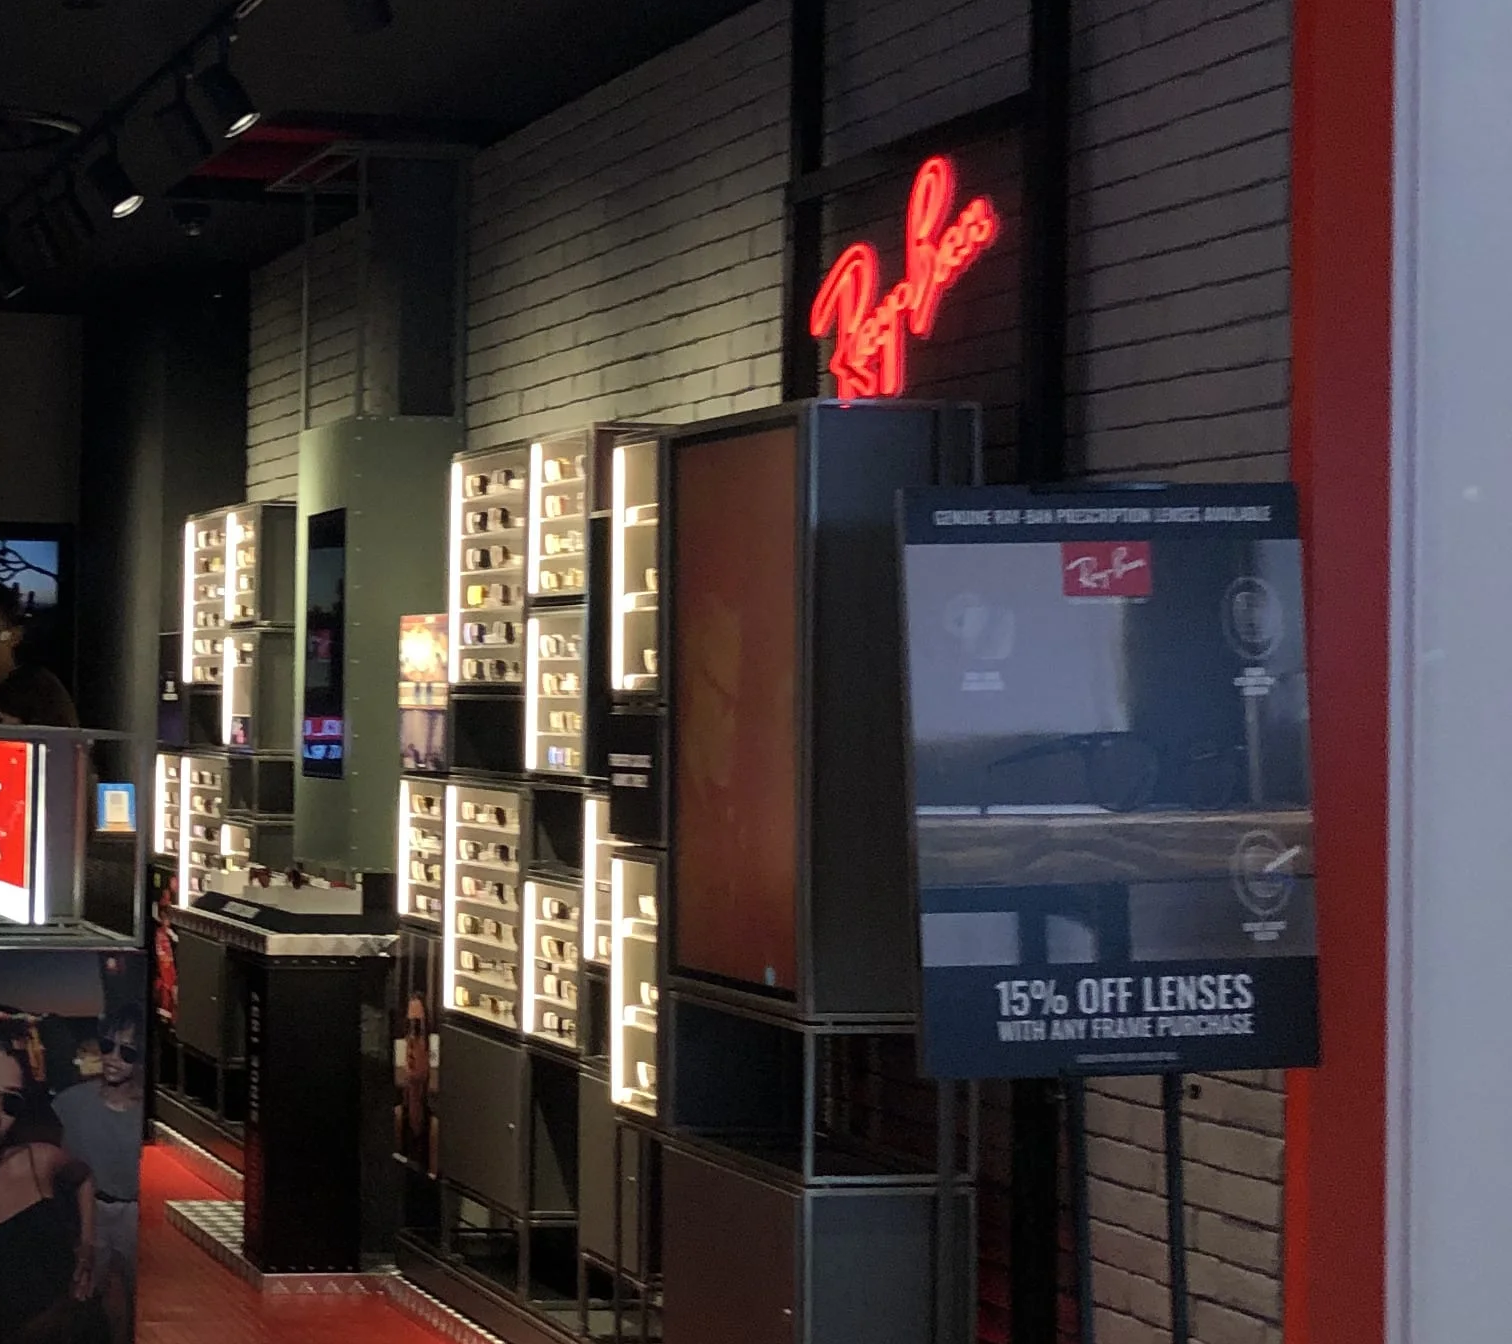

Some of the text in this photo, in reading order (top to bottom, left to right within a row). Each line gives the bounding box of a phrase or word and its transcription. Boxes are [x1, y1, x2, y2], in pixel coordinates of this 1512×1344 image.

[995, 973, 1255, 1017] 15% OFF LENSES
[996, 1013, 1255, 1042] WITH ANY FRAME PURCHASE
